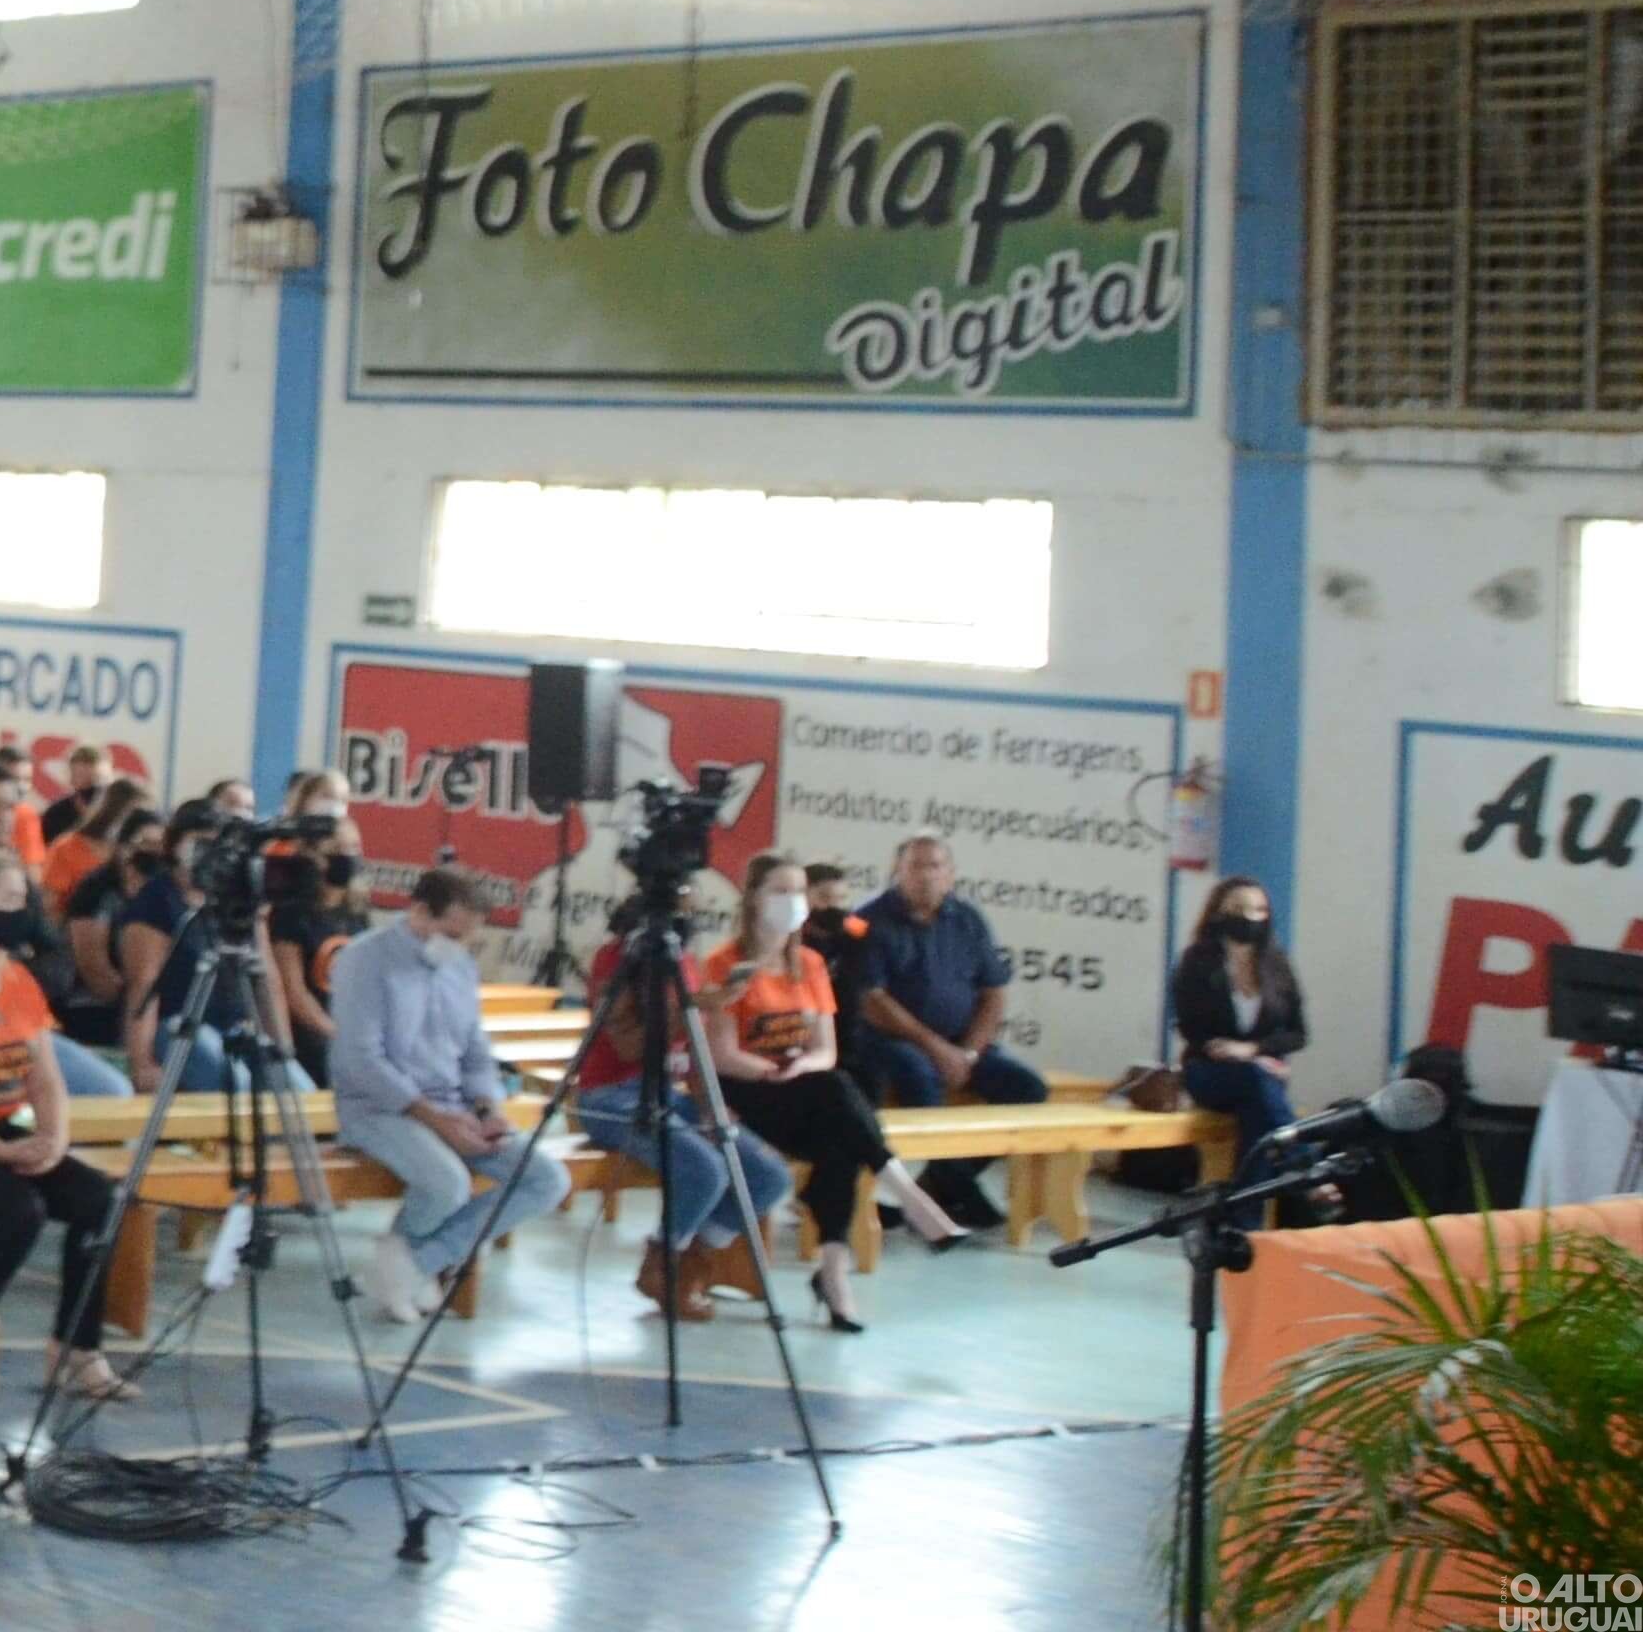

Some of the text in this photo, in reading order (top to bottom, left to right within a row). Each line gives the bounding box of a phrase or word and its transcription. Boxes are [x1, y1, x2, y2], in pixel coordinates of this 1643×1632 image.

[376, 68, 1174, 286] Foto Chapa
[830, 235, 1177, 393] Digital
[792, 716, 1144, 778] Comercio de Ferragens
[789, 783, 911, 824] Produtos
[958, 872, 1151, 924] ncentrados
